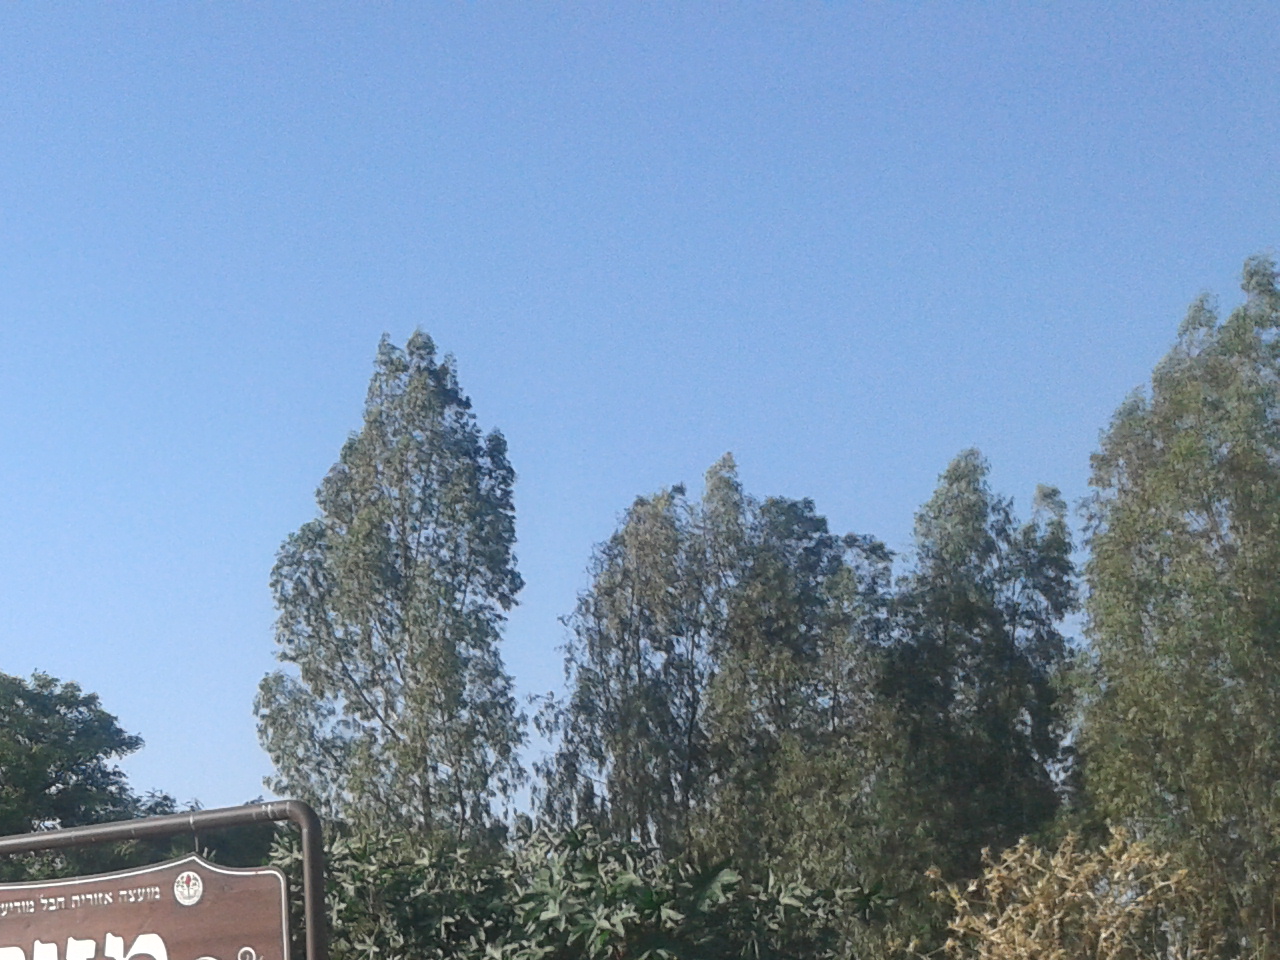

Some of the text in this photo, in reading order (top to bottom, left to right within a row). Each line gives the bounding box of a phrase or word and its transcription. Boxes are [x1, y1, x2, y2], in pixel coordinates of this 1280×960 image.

[40, 894, 65, 911] חבל
[71, 892, 113, 909] אזורית
[118, 886, 160, 902] מועצה
